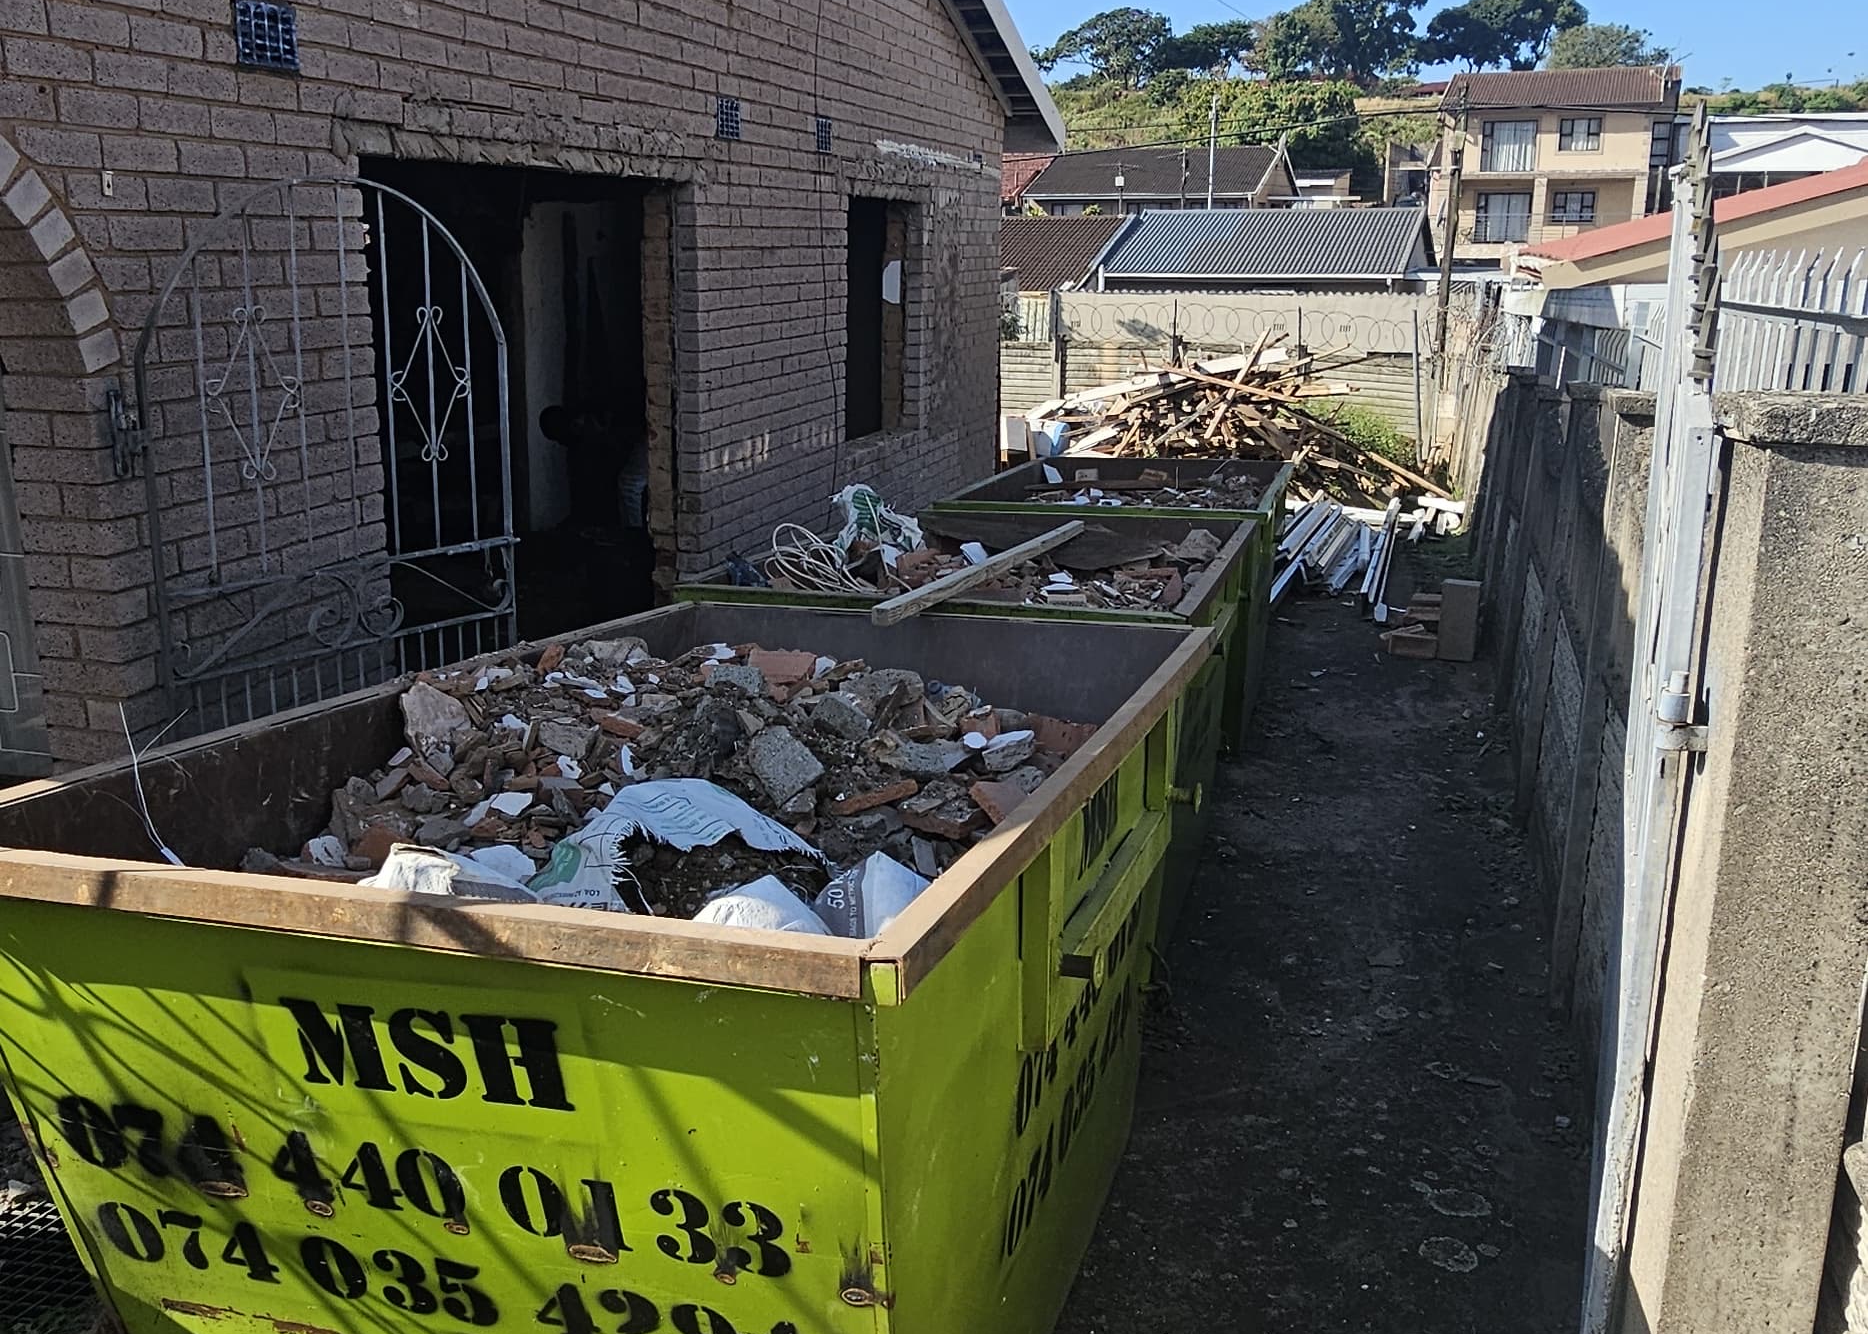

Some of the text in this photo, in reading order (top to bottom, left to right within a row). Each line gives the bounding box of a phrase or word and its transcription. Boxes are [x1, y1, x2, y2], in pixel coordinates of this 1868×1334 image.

[827, 888, 846, 910] 50
[279, 996, 576, 1112] MSH
[273, 1129, 470, 1222] 440
[498, 1165, 793, 1278] 0133
[1007, 1121, 1054, 1256] 074
[1059, 1035, 1098, 1164] 035
[97, 1200, 281, 1283] 074
[299, 1234, 500, 1327] 035
